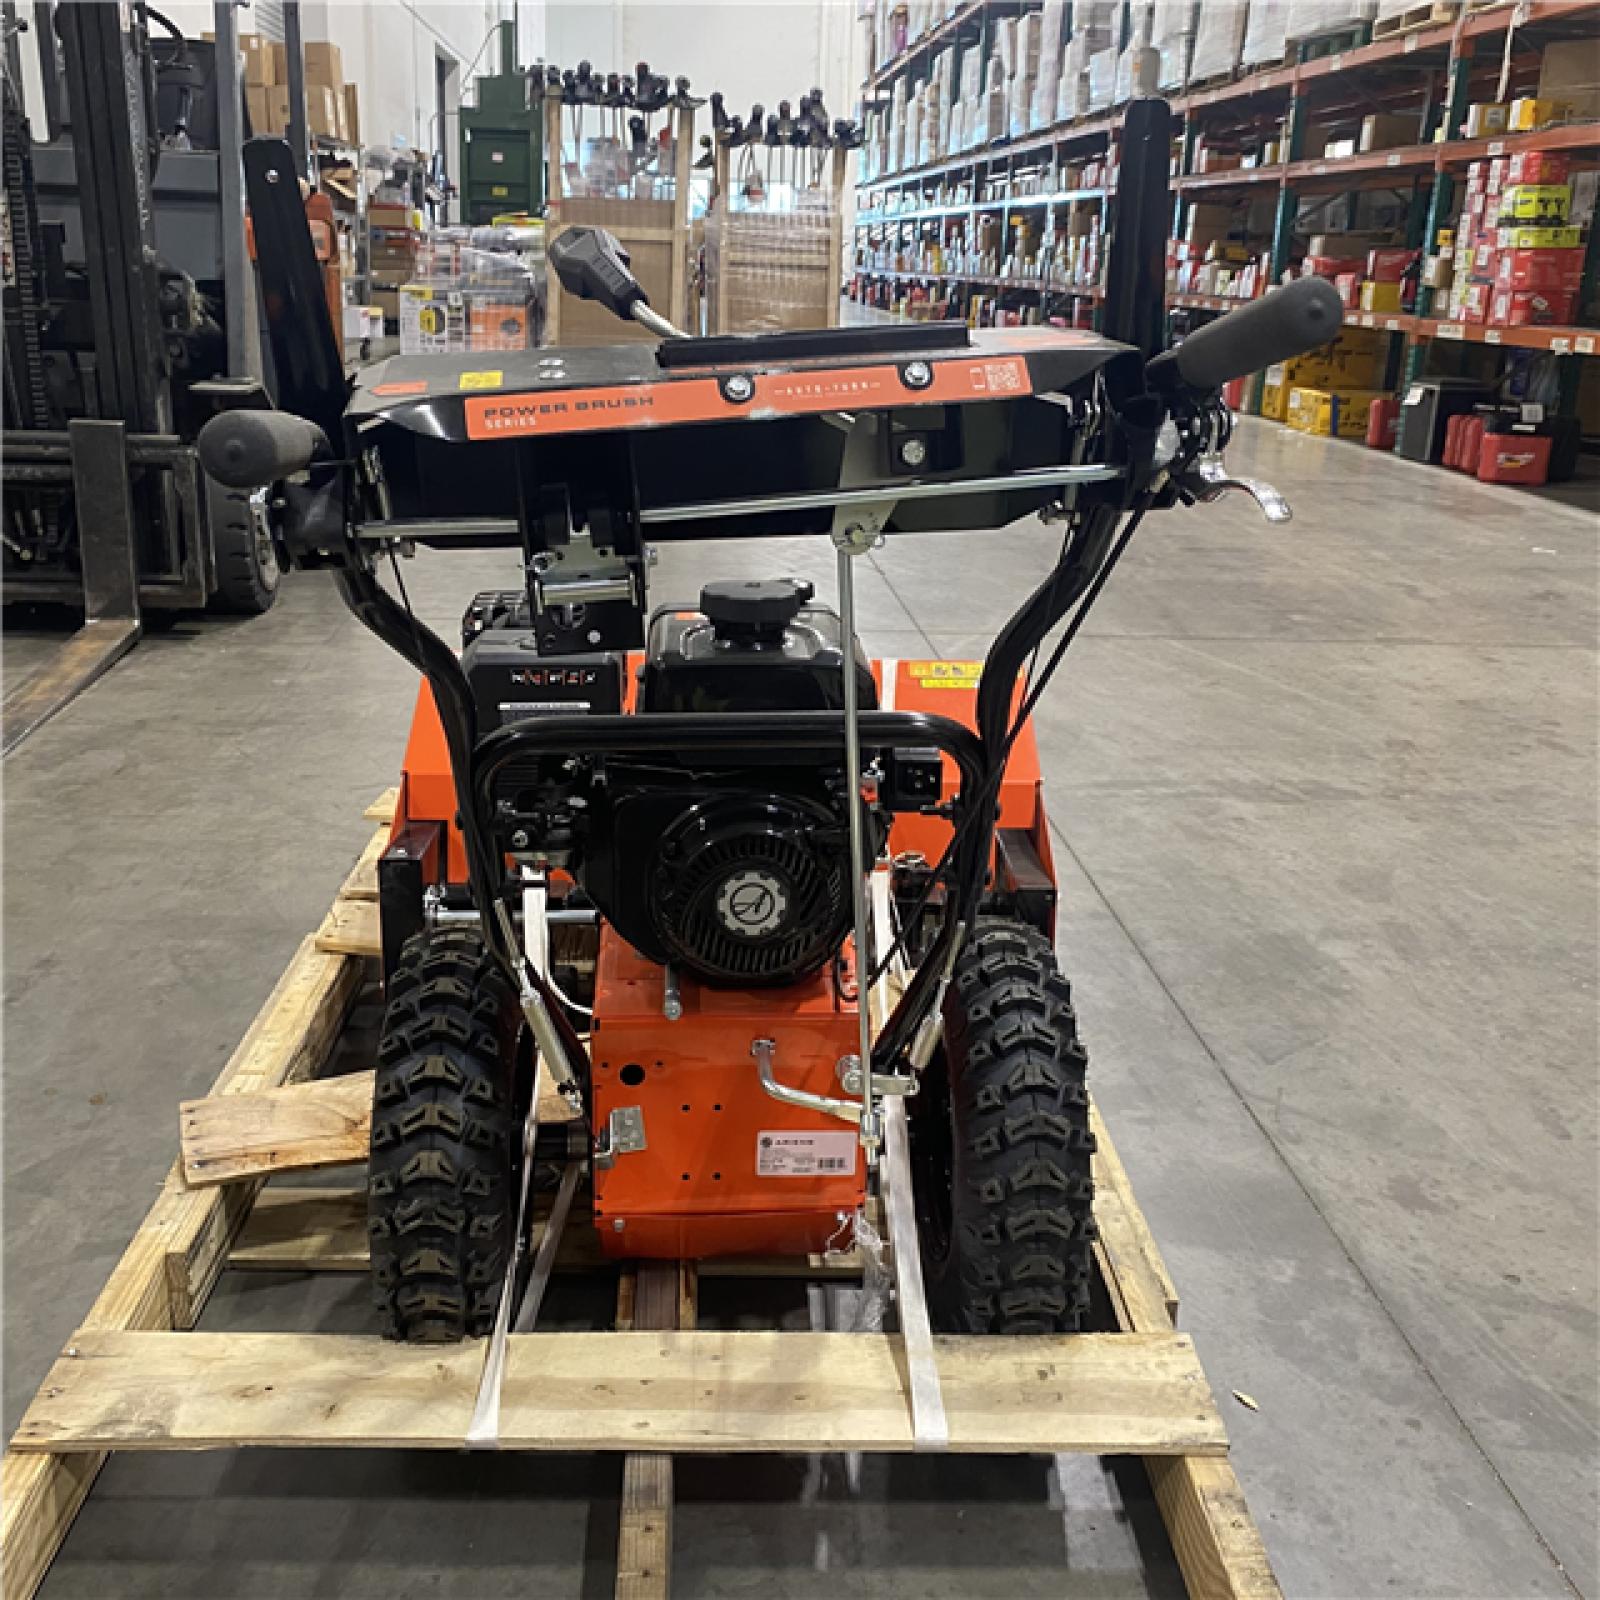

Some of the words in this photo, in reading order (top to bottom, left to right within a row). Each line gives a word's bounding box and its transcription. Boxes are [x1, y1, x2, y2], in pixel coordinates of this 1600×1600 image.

[484, 402, 568, 418] POWER
[574, 396, 654, 411] BRUSH
[484, 416, 536, 430] SERIES
